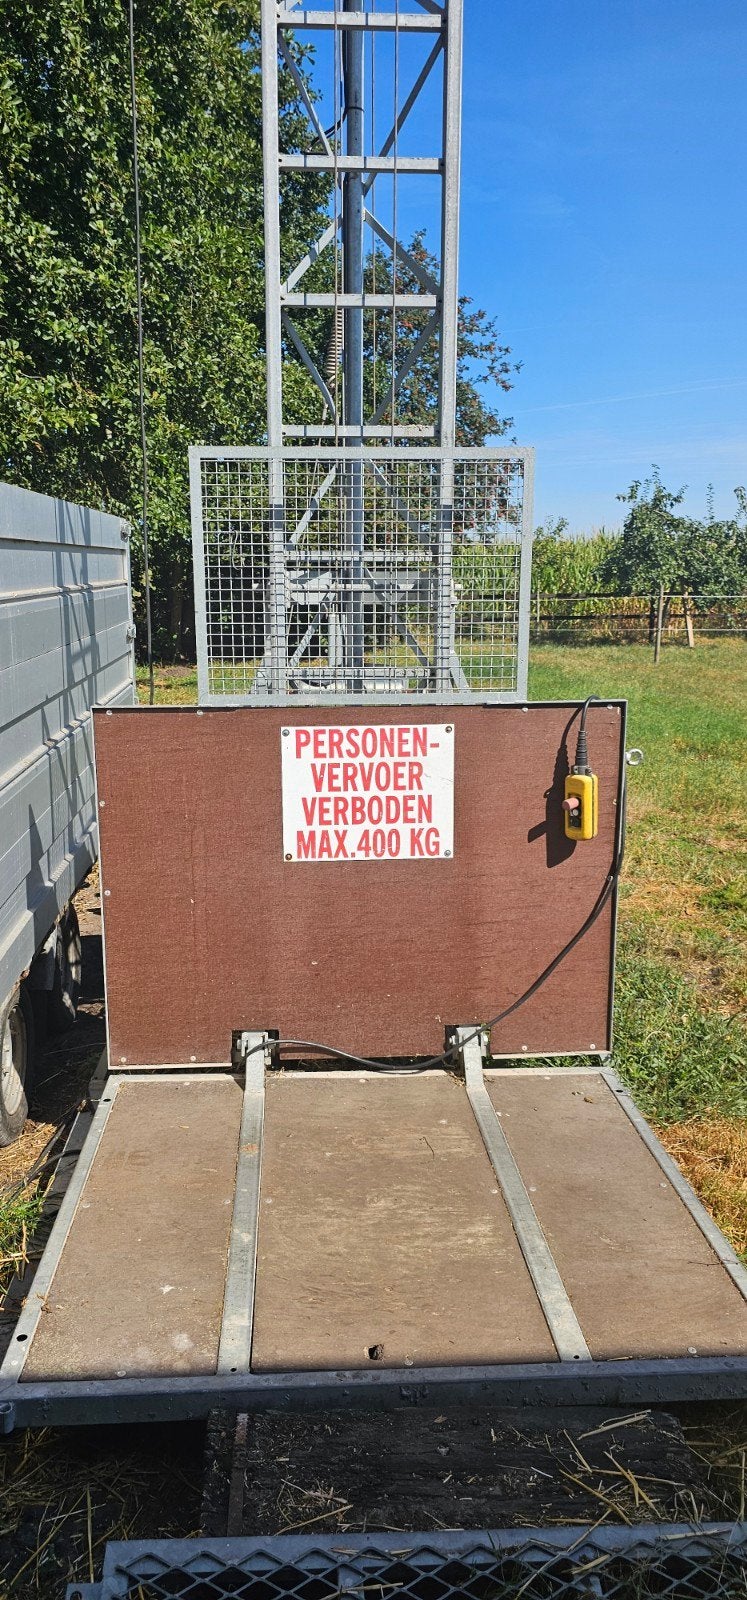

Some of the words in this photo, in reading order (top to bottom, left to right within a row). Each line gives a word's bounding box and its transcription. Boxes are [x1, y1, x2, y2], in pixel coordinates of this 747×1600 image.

[295, 727, 440, 759] PERSONEN-
[310, 761, 424, 793] VERVOER
[301, 794, 433, 826] VERBODEN
[410, 827, 440, 857] KG
